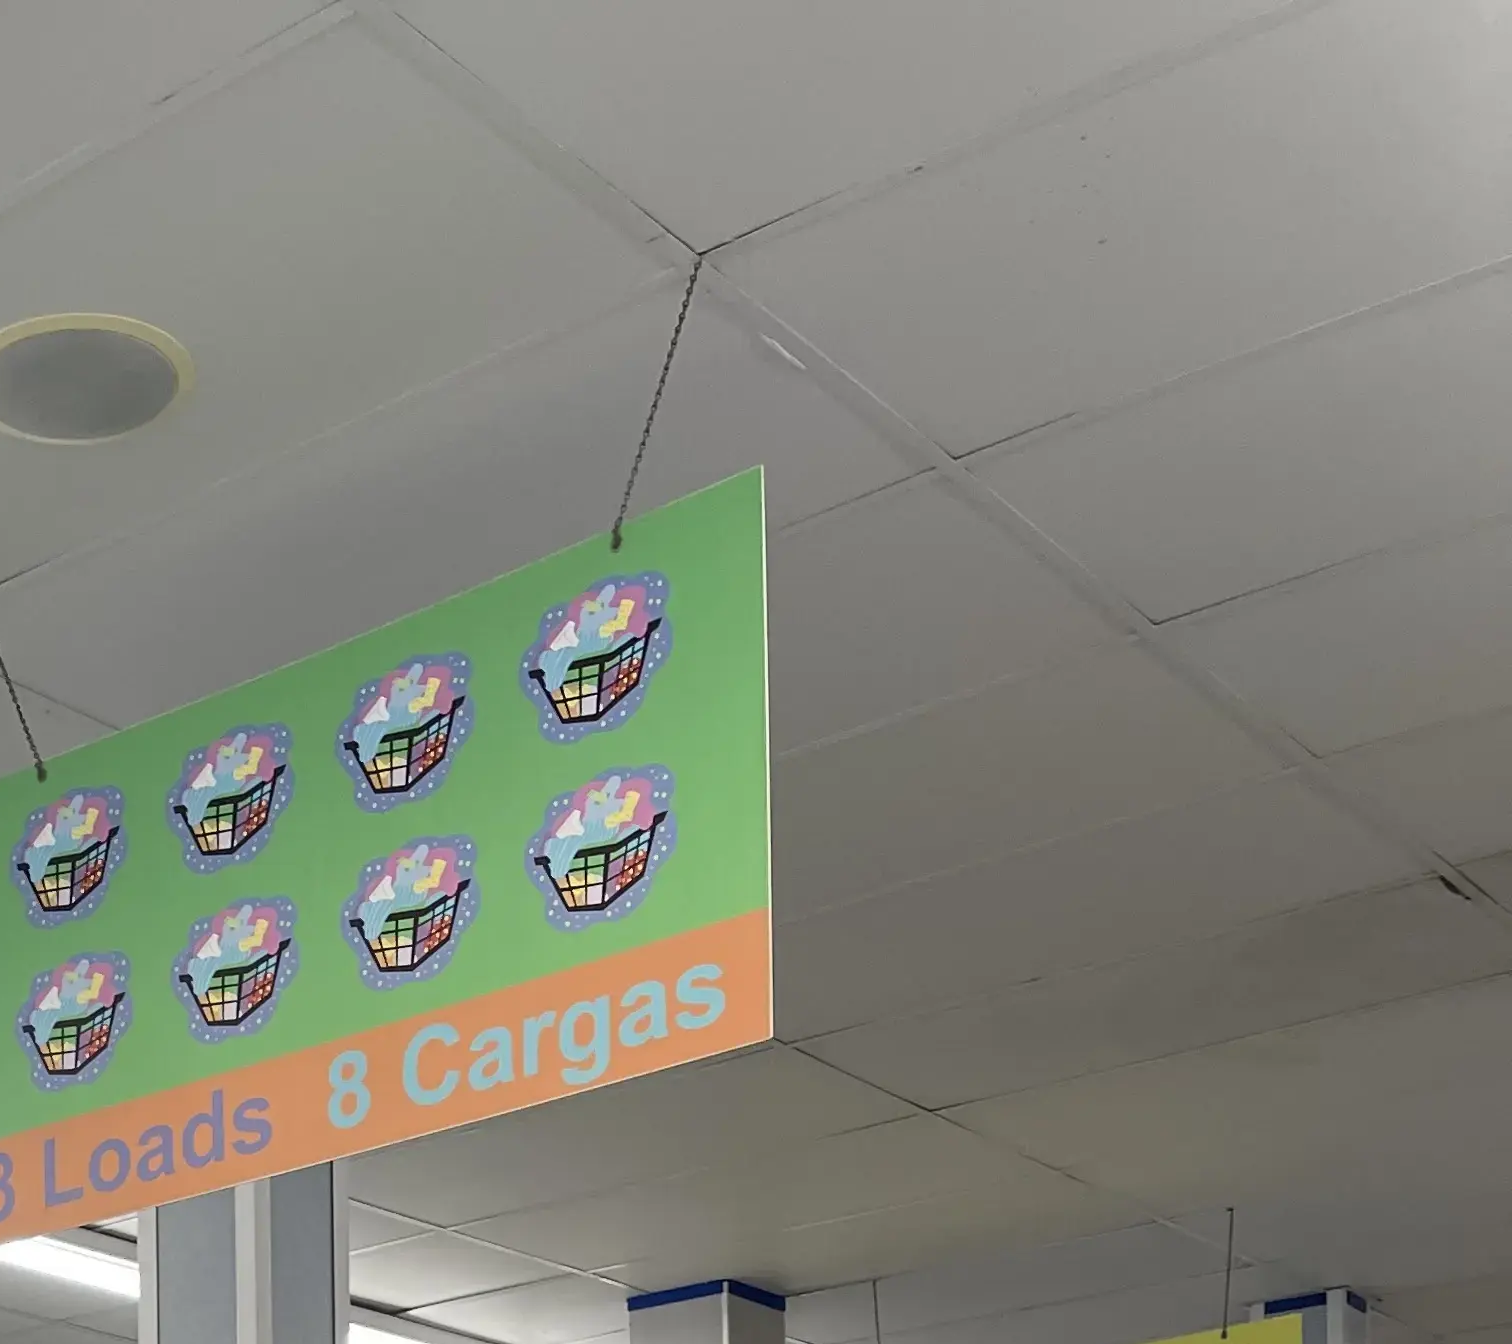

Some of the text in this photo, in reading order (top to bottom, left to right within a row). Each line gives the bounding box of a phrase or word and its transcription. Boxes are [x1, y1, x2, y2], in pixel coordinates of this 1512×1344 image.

[44, 1088, 274, 1209] Loads
[326, 1049, 370, 1129] 8
[402, 961, 727, 1107] Cargas
